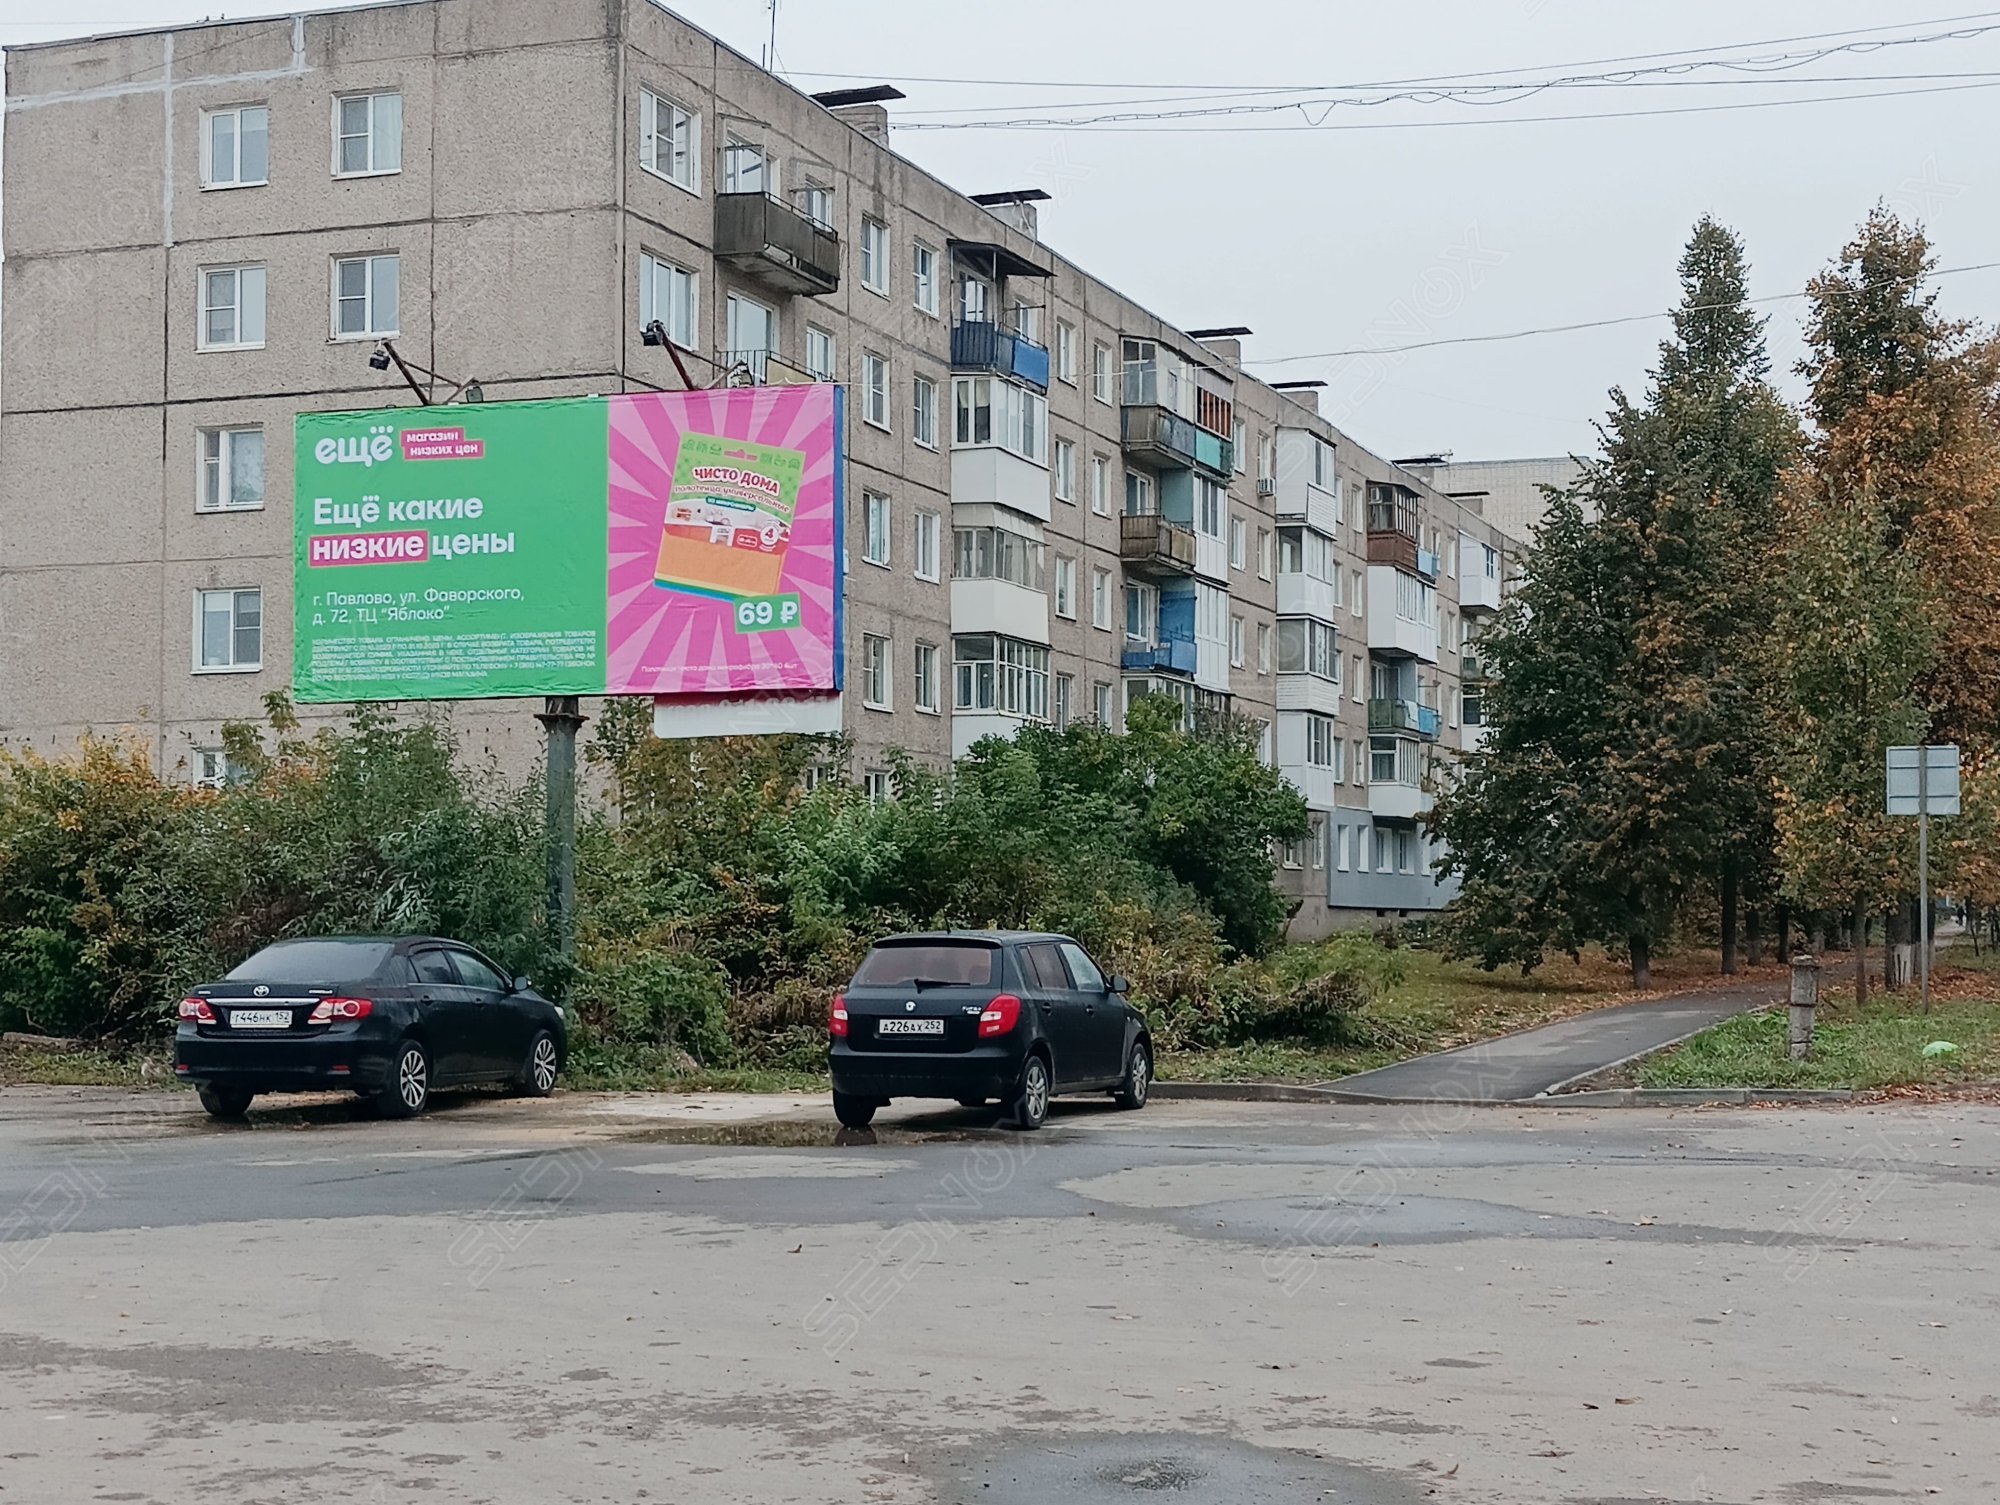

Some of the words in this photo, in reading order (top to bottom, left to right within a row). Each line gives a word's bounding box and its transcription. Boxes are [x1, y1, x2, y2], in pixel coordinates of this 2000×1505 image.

[315, 425, 394, 467] ещё
[406, 431, 459, 443] магазин
[410, 445, 453, 457] низких
[455, 443, 478, 455] цен
[740, 472, 778, 494] ДОМА
[314, 495, 380, 528] Ещё
[388, 497, 483, 521] какие
[313, 536, 424, 560] низкие
[432, 532, 514, 560] цены
[313, 596, 321, 606] г.
[326, 592, 396, 606] Павлово,
[400, 593, 420, 605] ул.
[424, 588, 524, 604] Фаворского,
[313, 612, 326, 625] д.
[331, 610, 352, 624] 72,
[356, 610, 377, 623] ТЦ
[738, 602, 772, 624] 69
